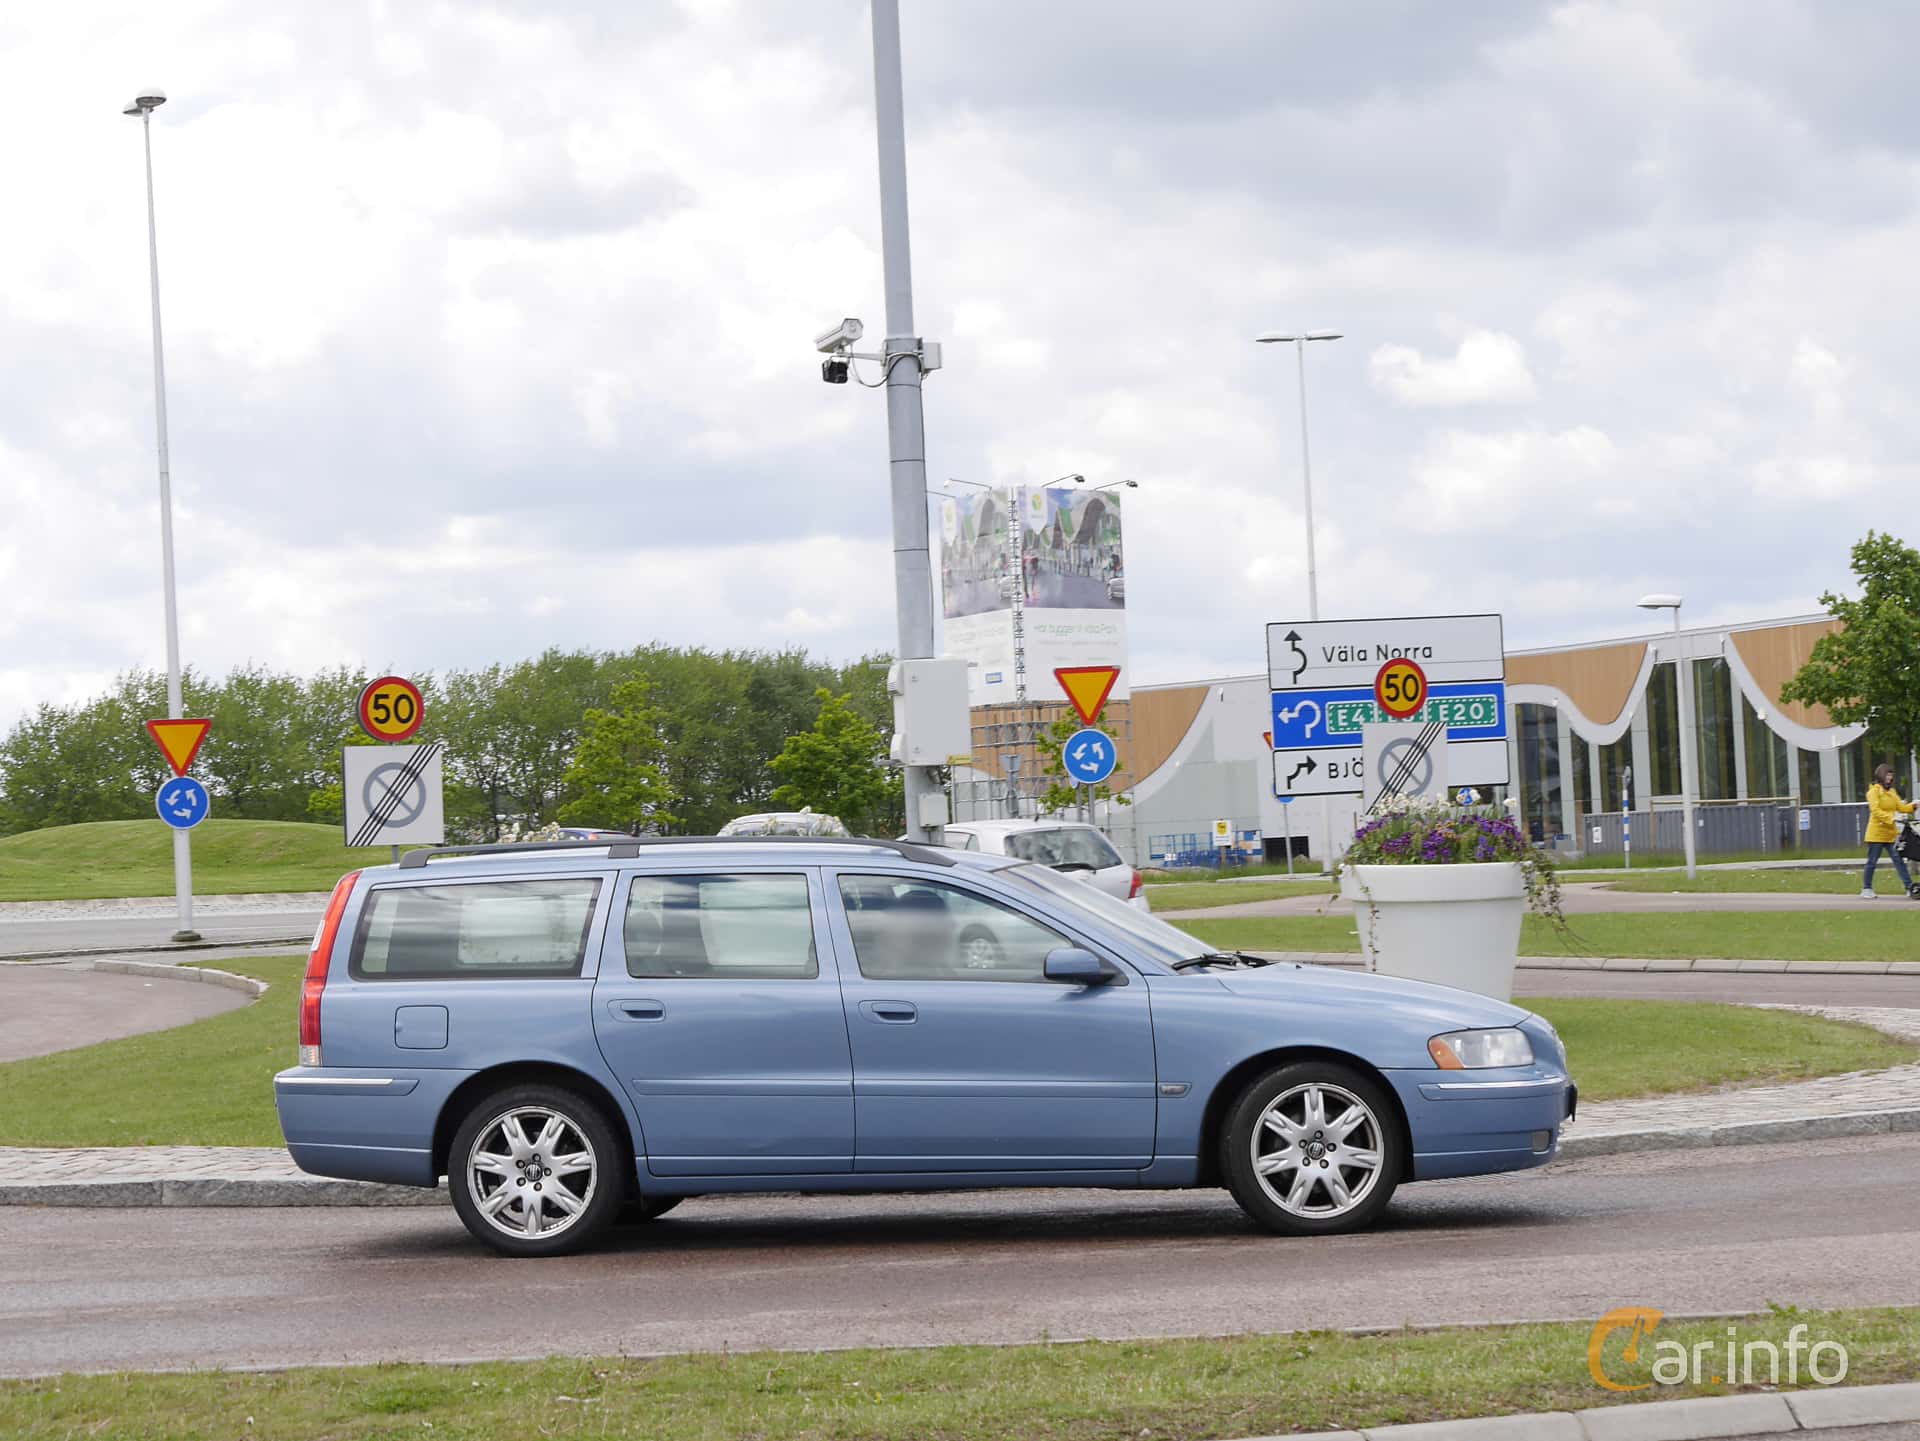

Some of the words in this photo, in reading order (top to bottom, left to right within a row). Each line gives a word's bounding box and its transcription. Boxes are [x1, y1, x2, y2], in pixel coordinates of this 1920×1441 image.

[1321, 645, 1368, 663] Väla
[1376, 643, 1433, 660] Norra
[1385, 673, 1420, 702] 50
[372, 693, 415, 724] 50
[1337, 708, 1366, 726] E4
[1438, 702, 1485, 721] E20
